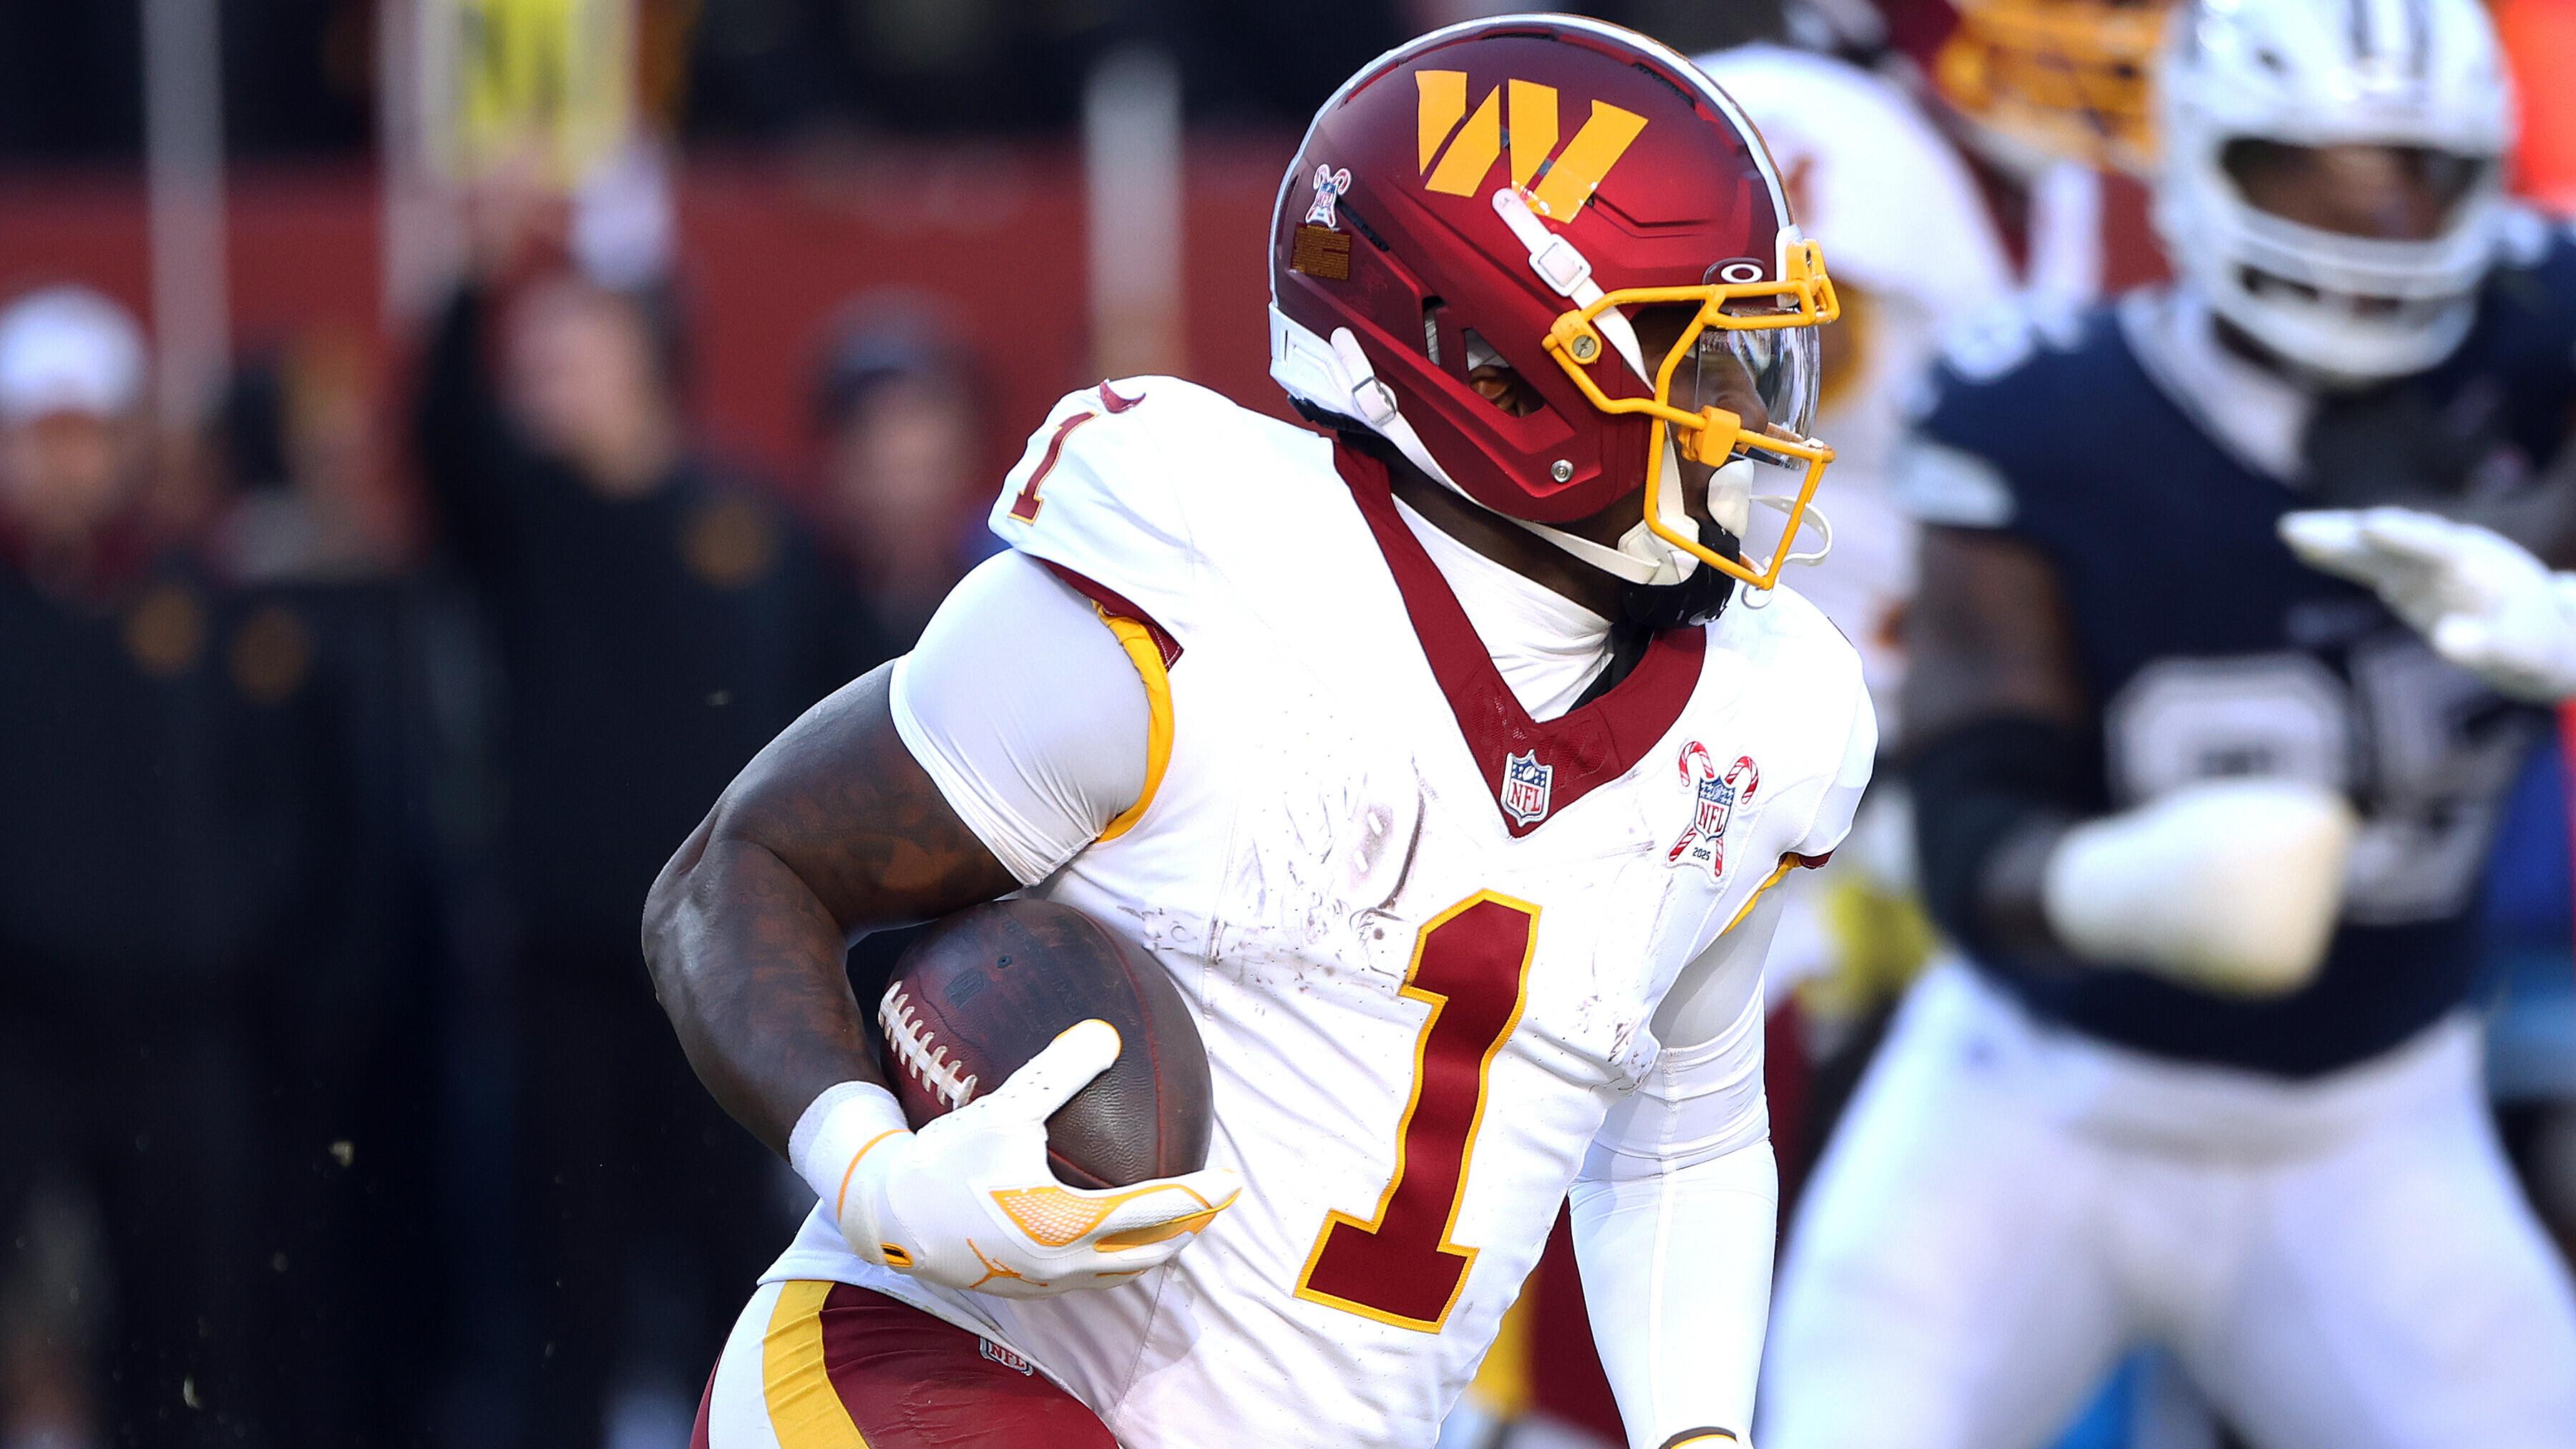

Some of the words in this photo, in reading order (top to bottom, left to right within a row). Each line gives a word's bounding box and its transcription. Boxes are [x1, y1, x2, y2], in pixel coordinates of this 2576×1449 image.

[1008, 410, 1101, 526] 1
[1510, 781, 1541, 813] NFL
[1697, 801, 1724, 834] NFL
[1692, 847, 1711, 861] 2025
[1292, 887, 1543, 1336] 1
[990, 1343, 1025, 1367] NFL
